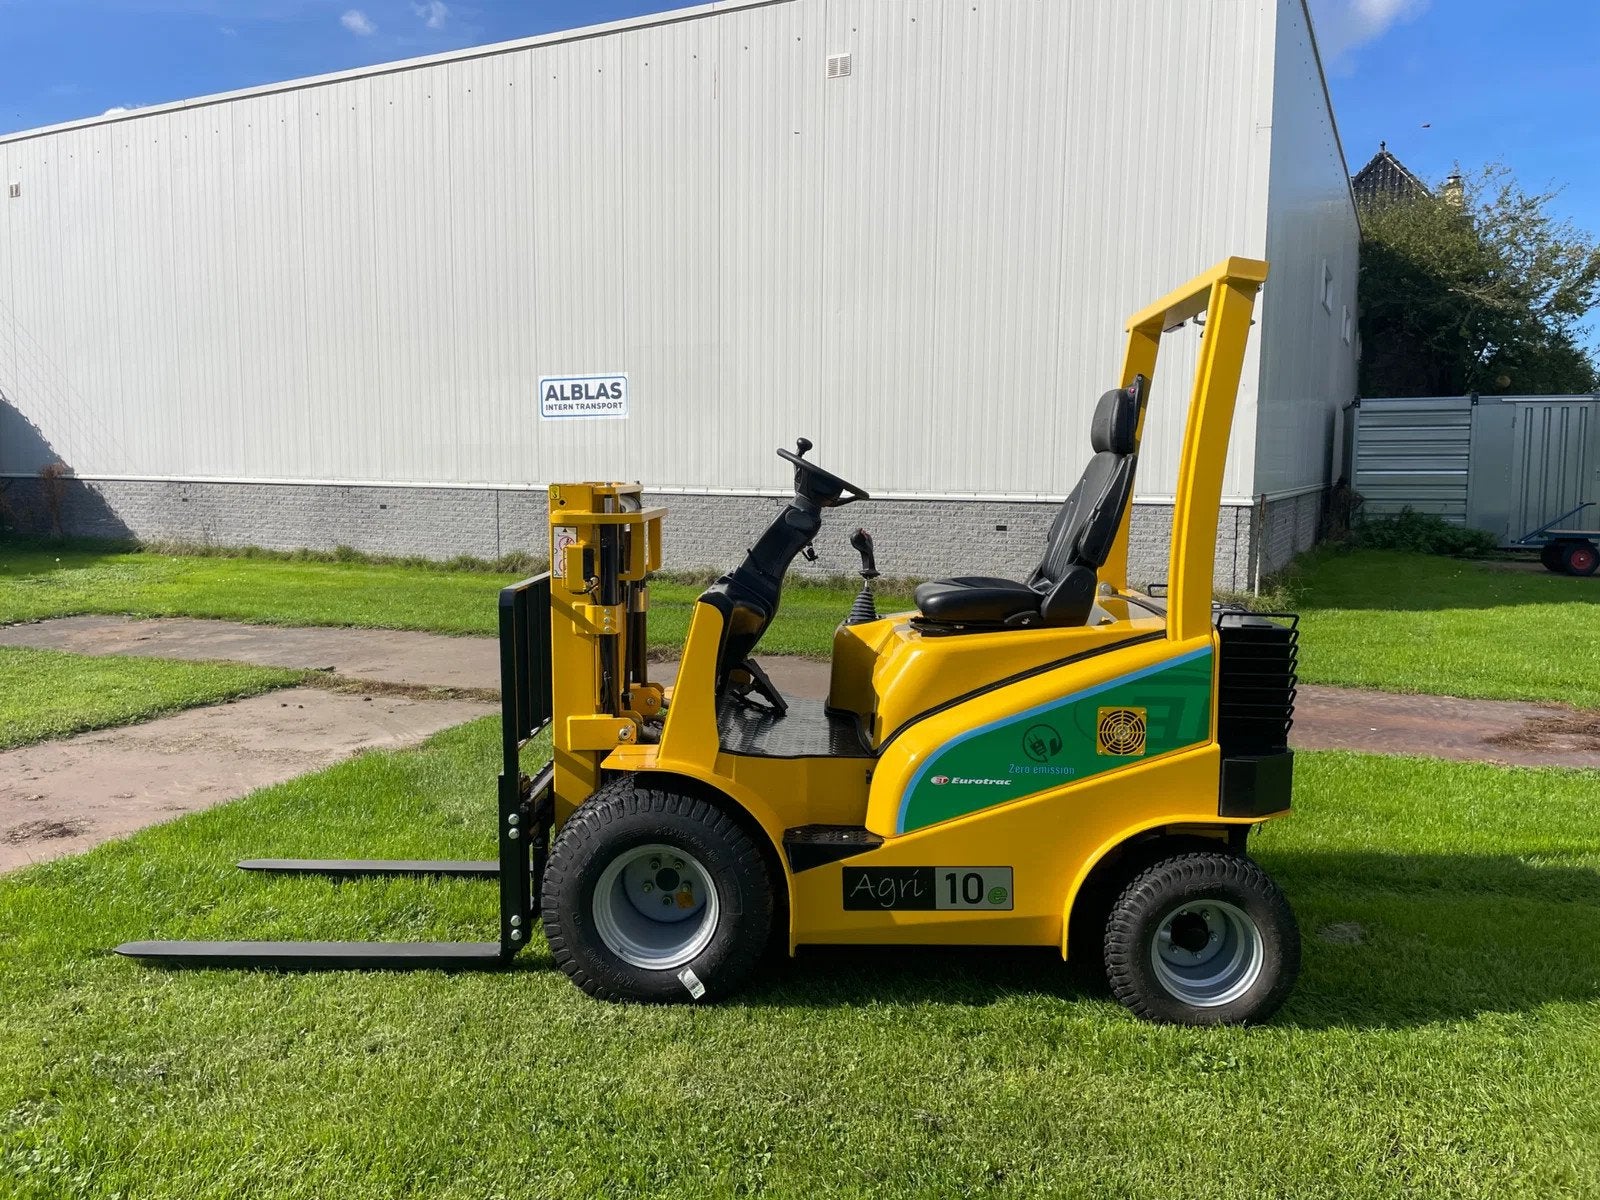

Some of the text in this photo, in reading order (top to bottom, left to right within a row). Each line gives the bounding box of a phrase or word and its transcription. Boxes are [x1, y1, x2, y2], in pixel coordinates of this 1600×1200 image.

[545, 382, 622, 401] ALBLAS
[546, 402, 623, 411] INTERN TRANSPORT
[1008, 763, 1075, 775] Zero emission
[951, 777, 1012, 786] Eurotrac
[850, 869, 923, 908] Agri
